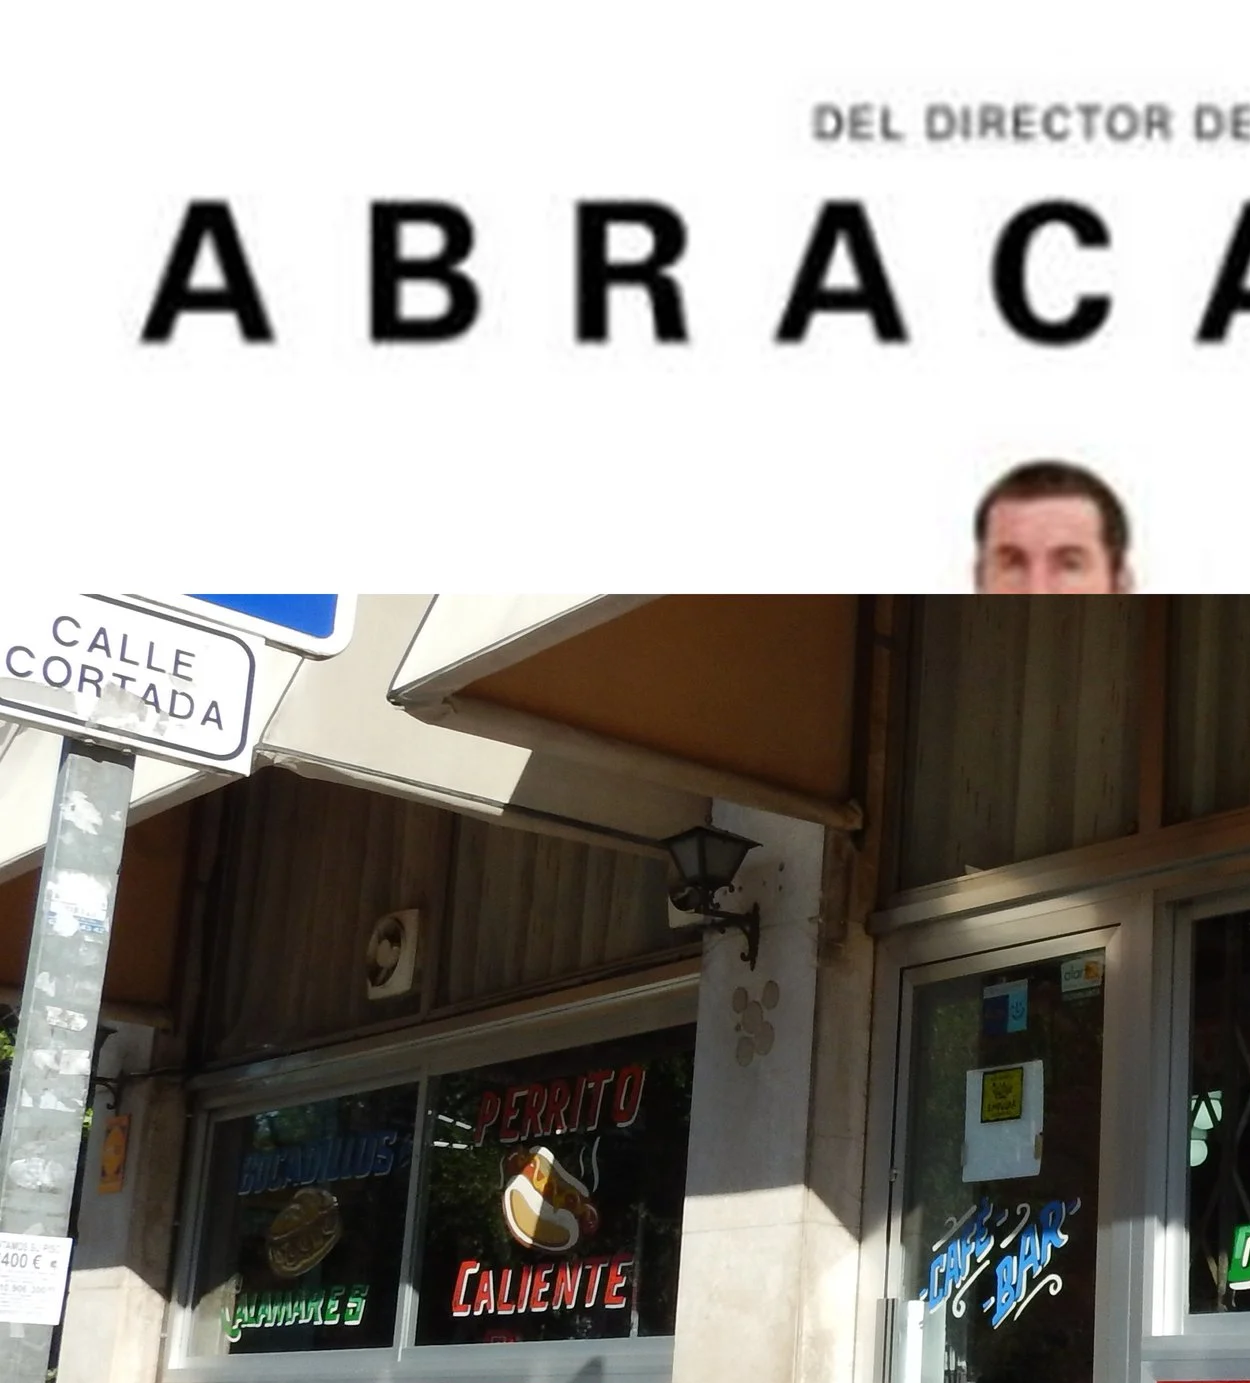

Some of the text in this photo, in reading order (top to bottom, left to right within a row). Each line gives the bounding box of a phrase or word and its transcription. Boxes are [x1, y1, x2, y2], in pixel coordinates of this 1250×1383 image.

[812, 104, 903, 140] DEL
[926, 104, 1173, 140] DIRECTOR
[52, 615, 196, 682] CALLE
[5, 645, 224, 731] CORTADA
[474, 1065, 647, 1147] PERRITO
[452, 1253, 635, 1318] CALIENTE
[992, 1200, 1069, 1330] BAR
[220, 1272, 371, 1343] CALAMARES
